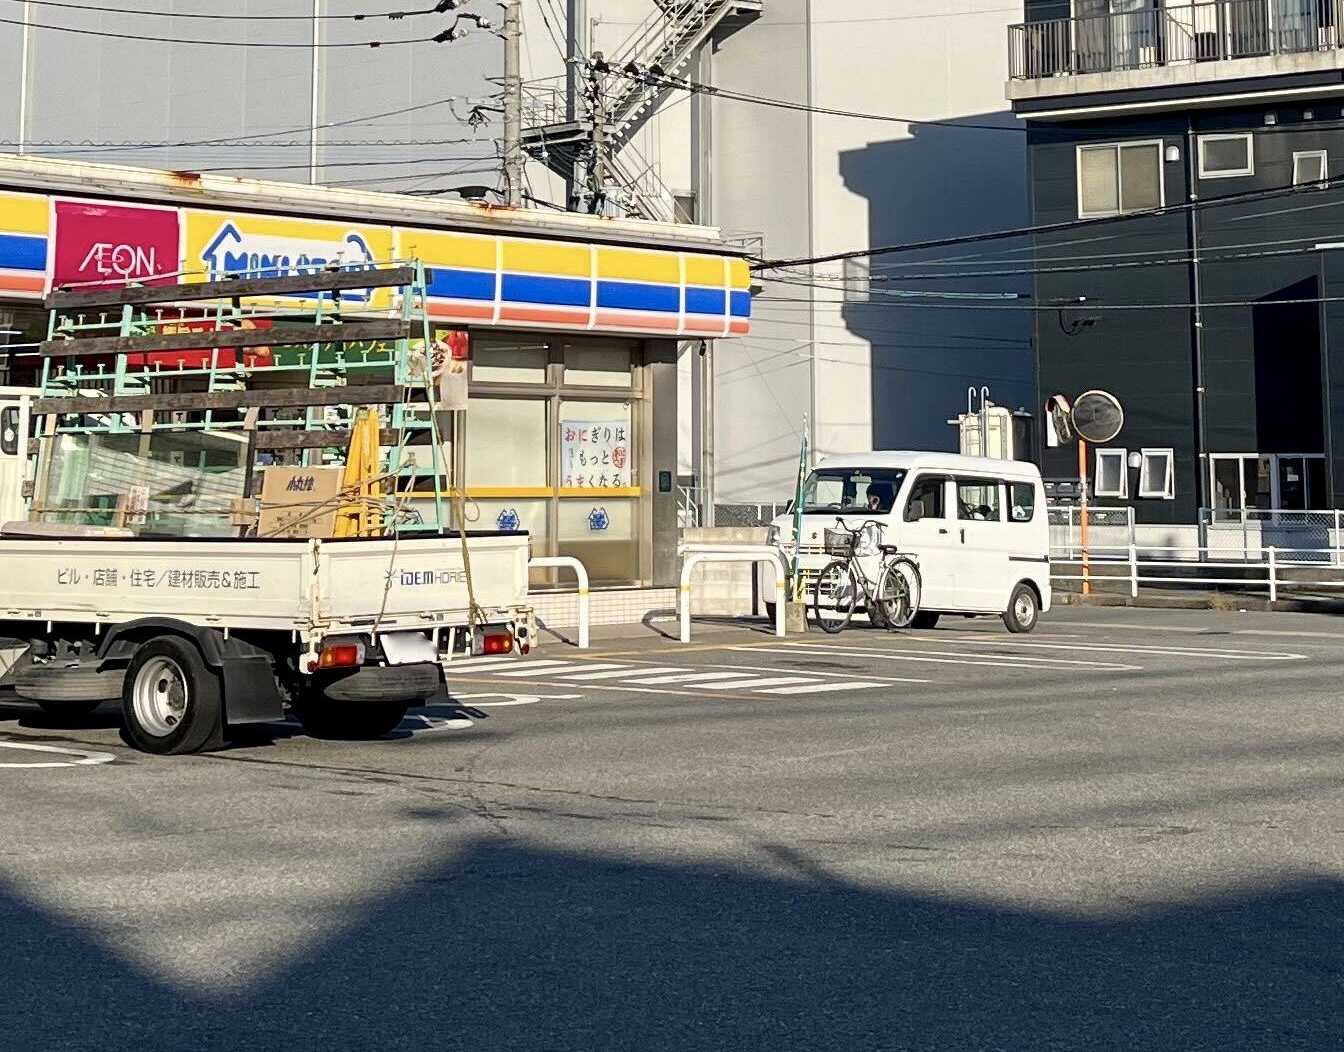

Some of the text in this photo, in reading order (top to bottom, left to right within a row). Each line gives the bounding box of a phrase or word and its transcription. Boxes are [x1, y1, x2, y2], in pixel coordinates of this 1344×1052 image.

[565, 426, 626, 444] おにぎりは
[579, 449, 610, 467] もっと
